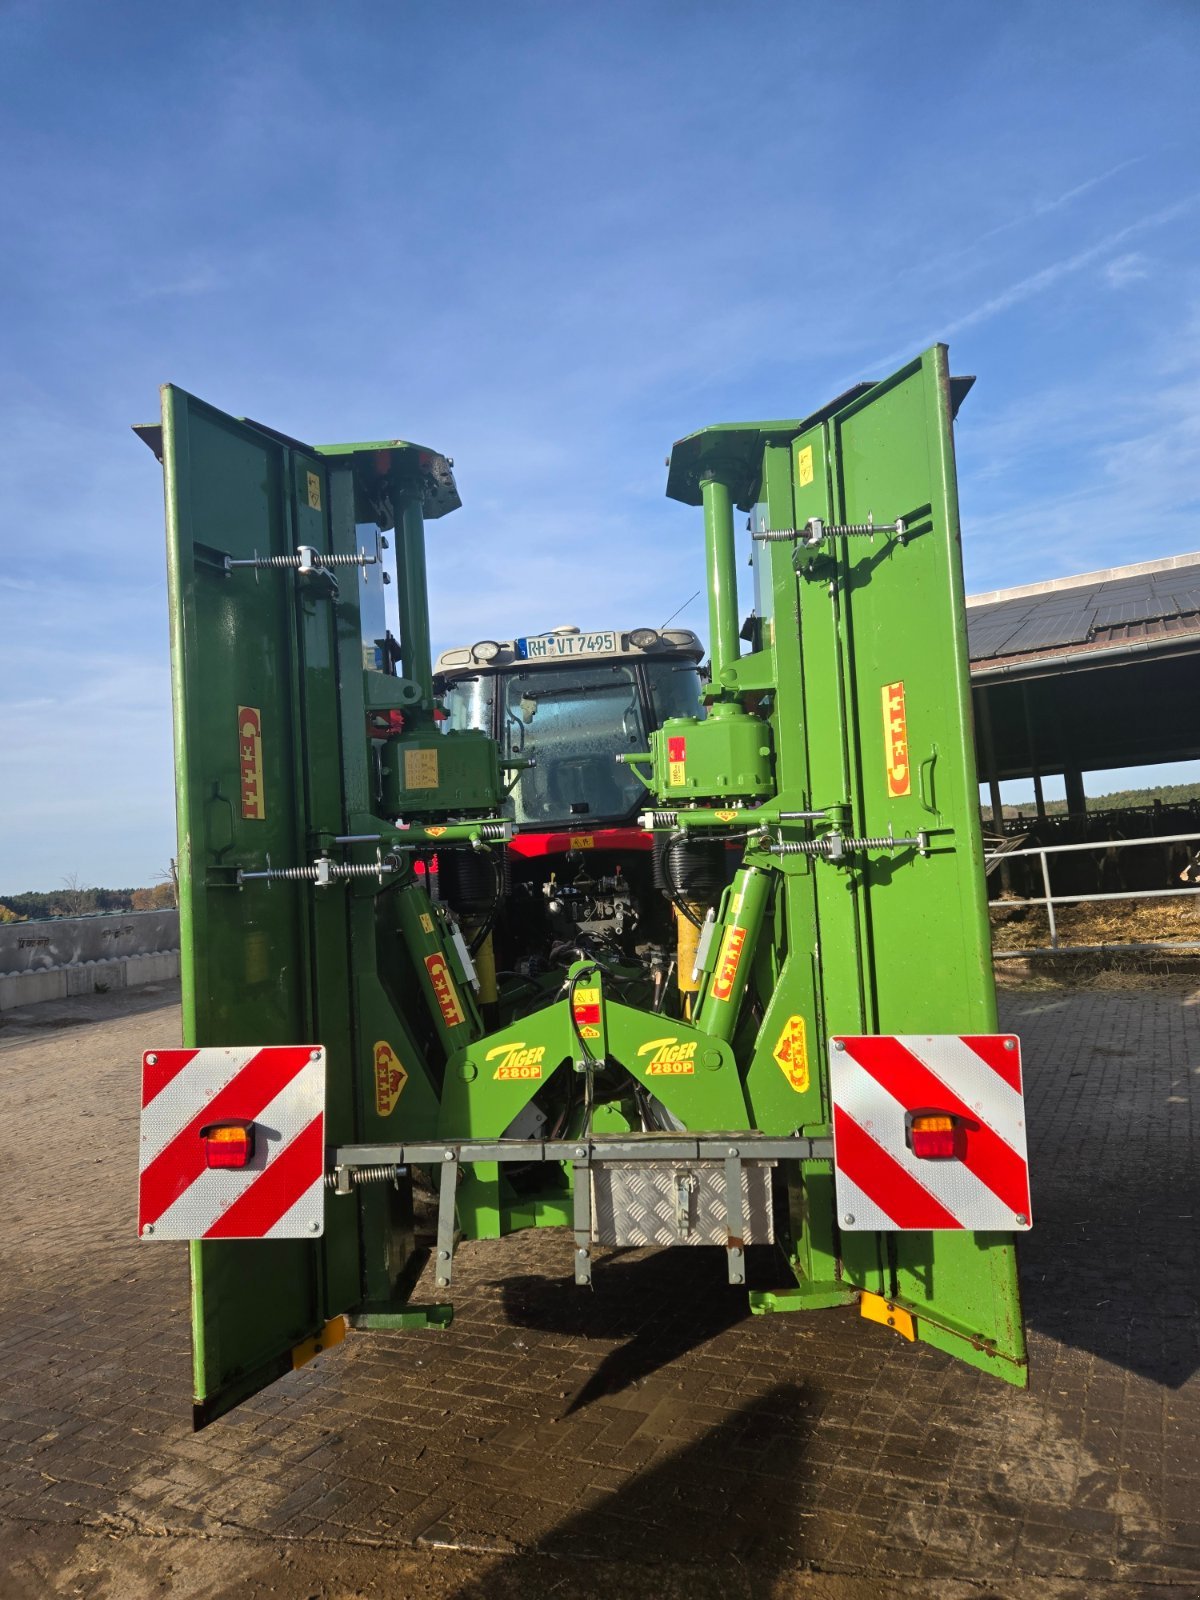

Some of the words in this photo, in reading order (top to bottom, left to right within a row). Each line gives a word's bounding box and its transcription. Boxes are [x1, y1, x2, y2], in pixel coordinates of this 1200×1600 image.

[528, 641, 546, 656] RH
[557, 638, 573, 654] VT
[578, 634, 613, 651] 7495
[238, 707, 260, 818] CELLI
[888, 681, 909, 795] CELLI
[714, 929, 747, 999] CELLI
[426, 954, 461, 1028] CELLI
[376, 1046, 393, 1112] CELLI
[485, 1042, 546, 1080] TIGER
[500, 1067, 540, 1078] 280P
[637, 1037, 698, 1076] TIGER
[652, 1062, 692, 1074] 280P
